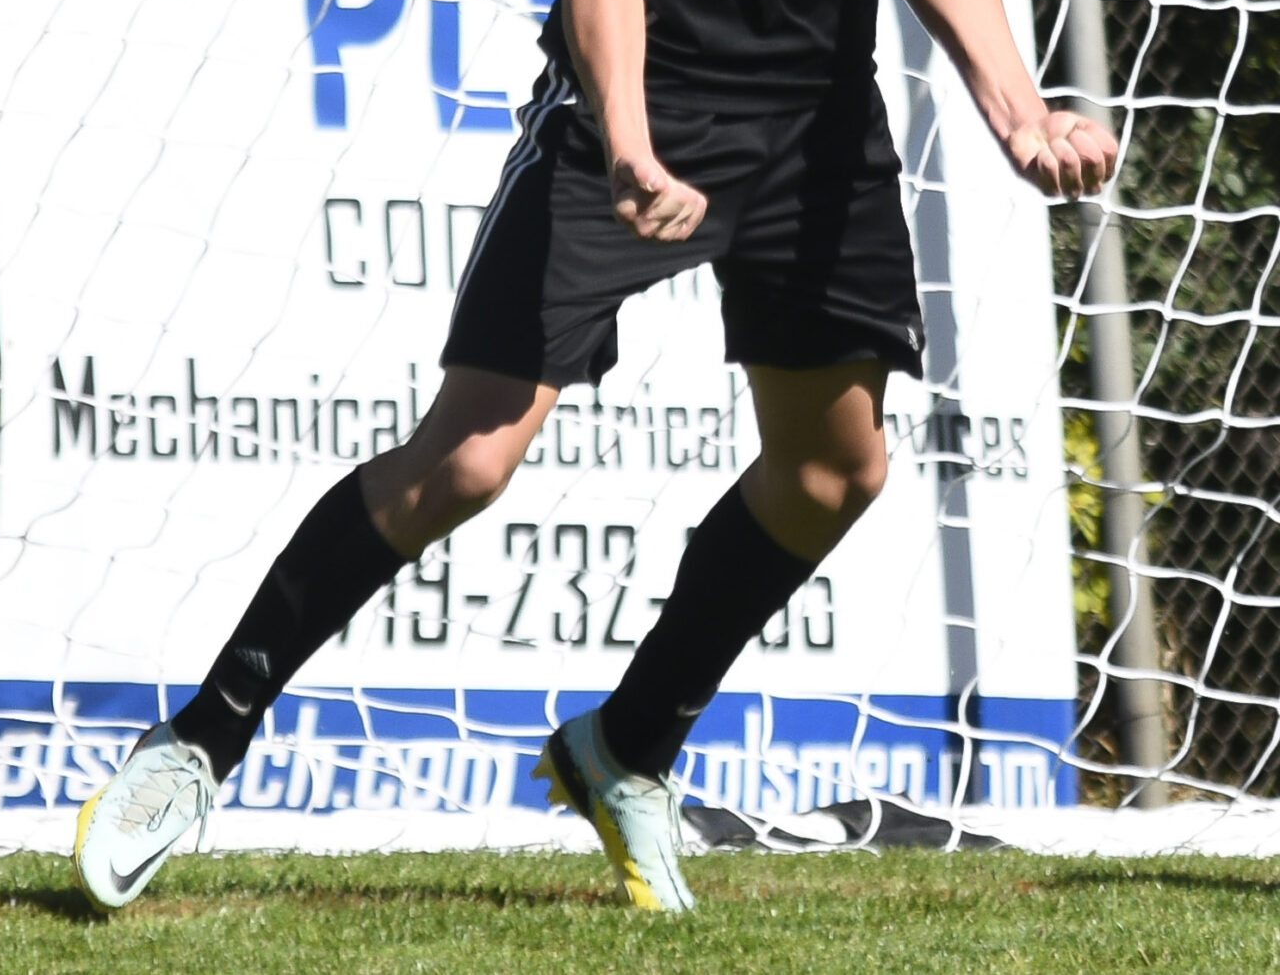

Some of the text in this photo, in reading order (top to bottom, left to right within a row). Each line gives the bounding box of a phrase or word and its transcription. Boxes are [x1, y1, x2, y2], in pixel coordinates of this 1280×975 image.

[48, 355, 1028, 478] Mechanical ctrical vices
